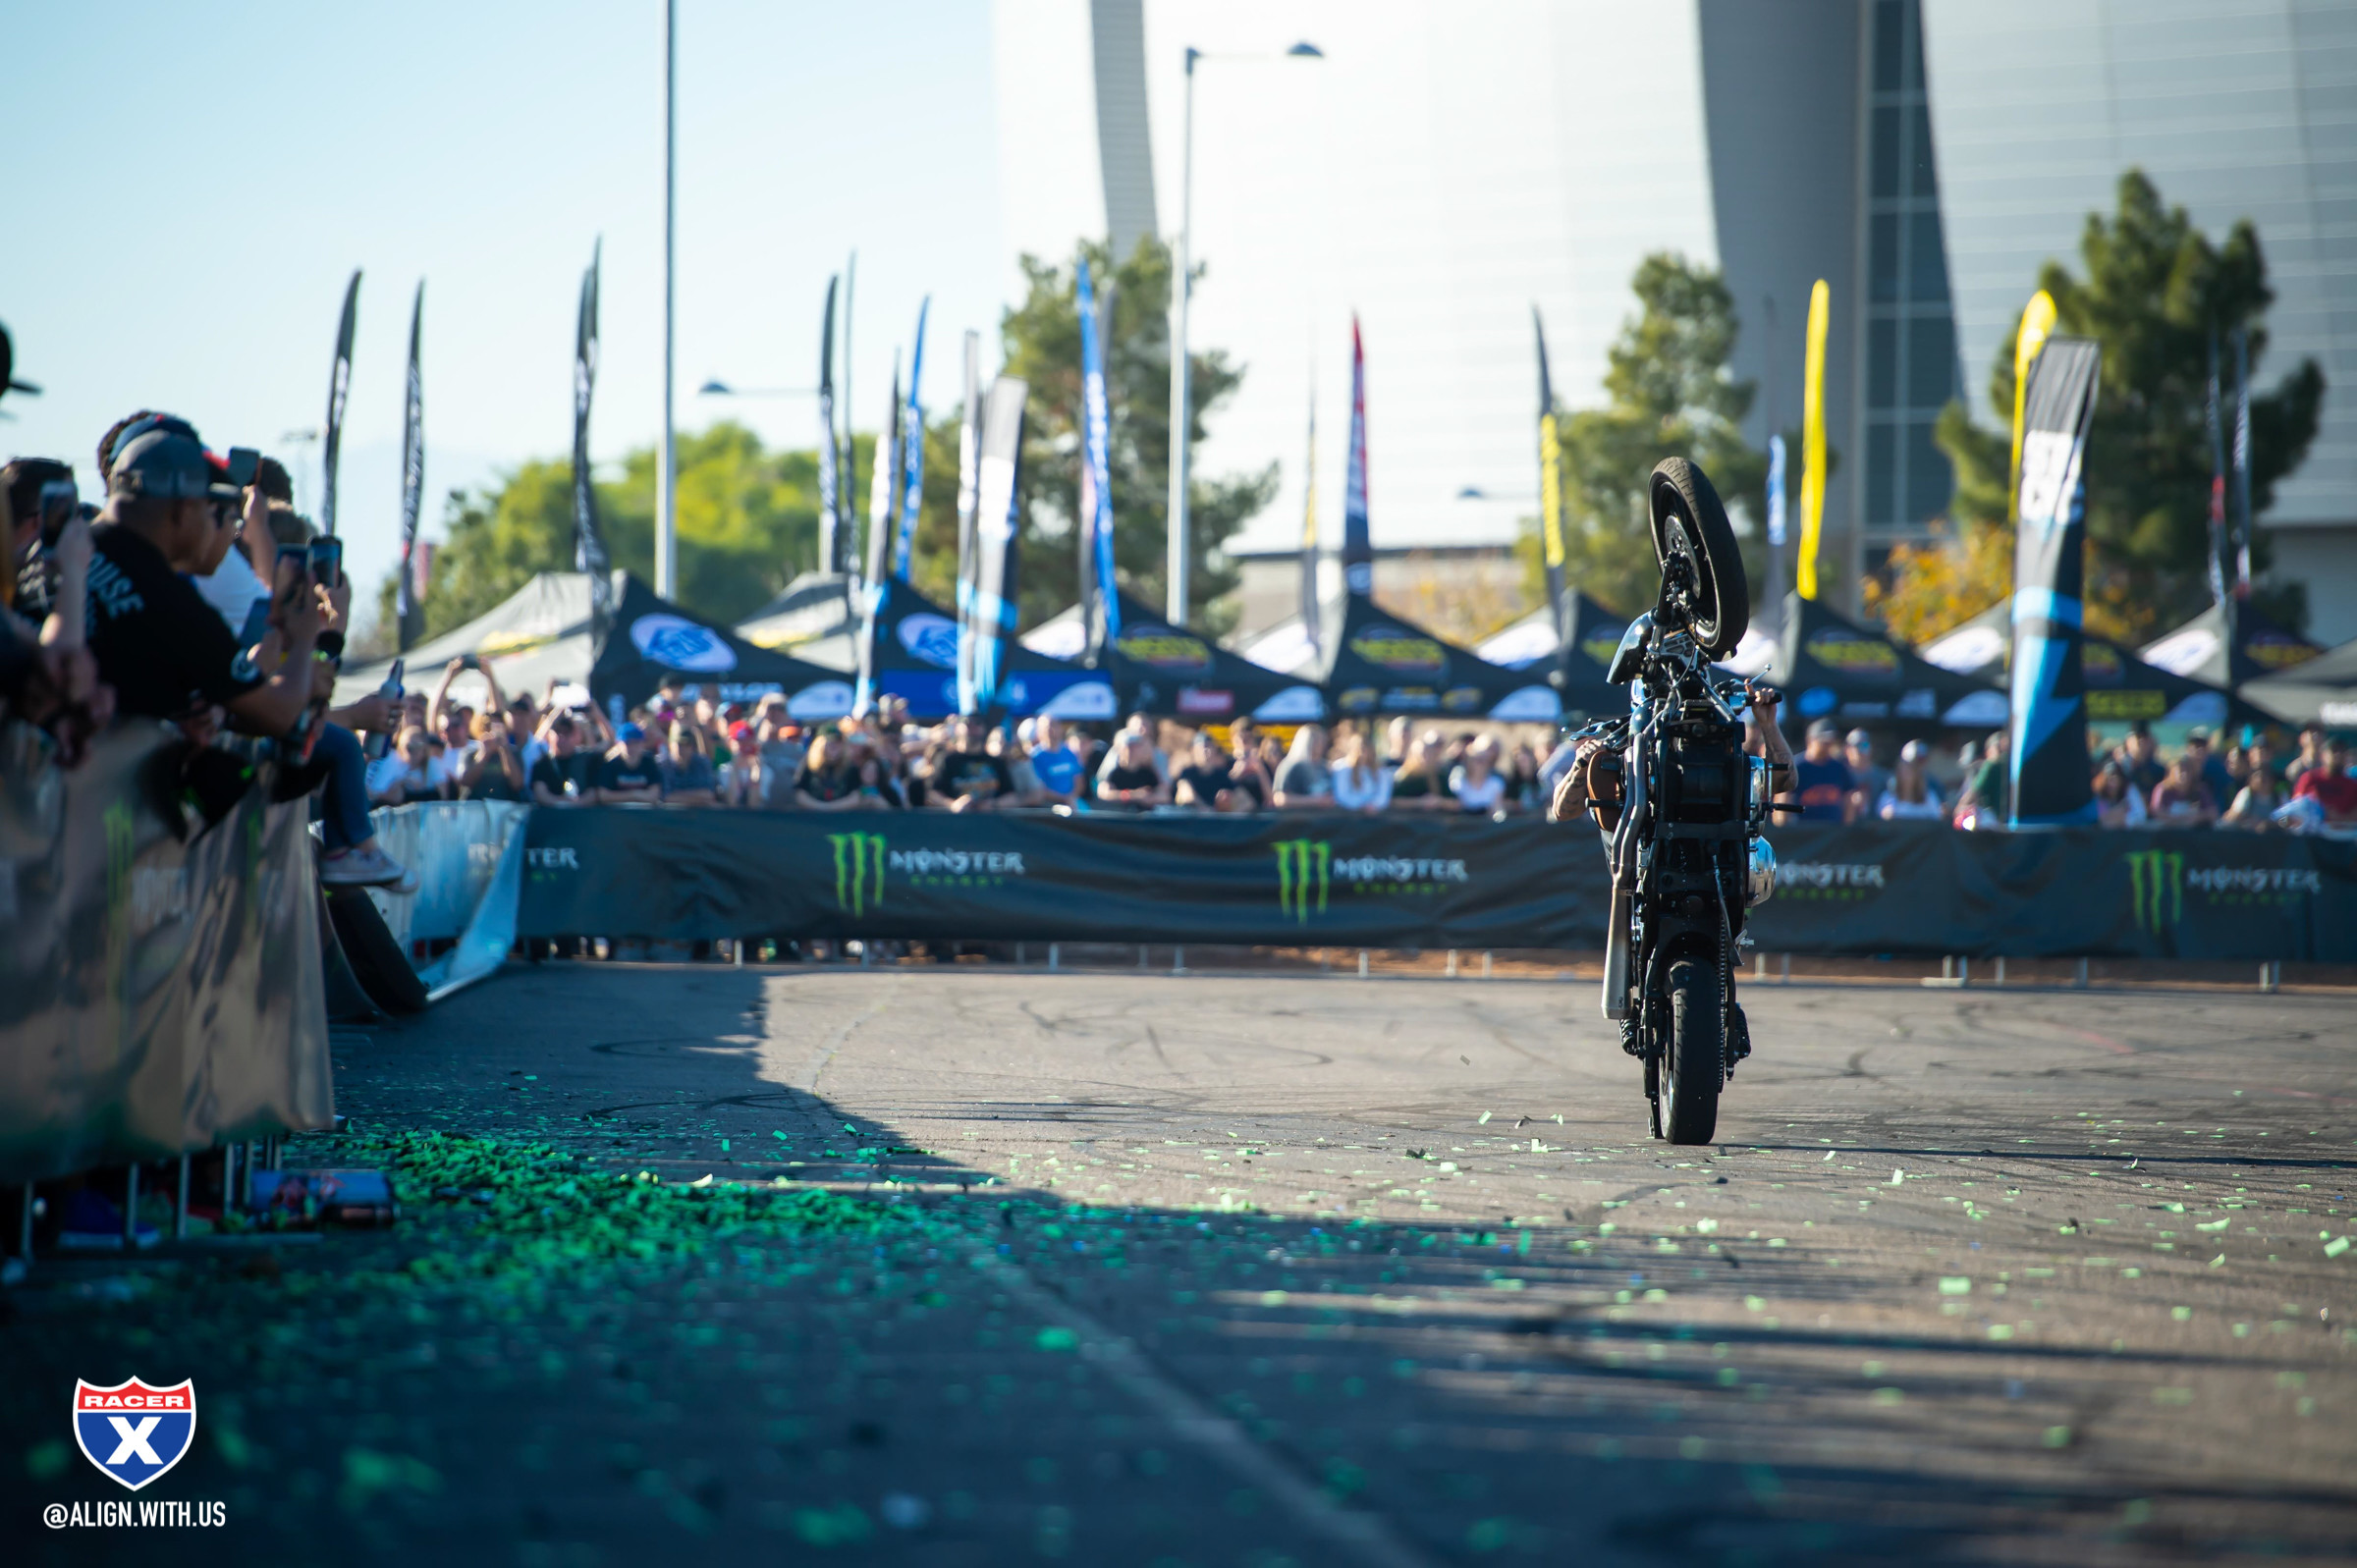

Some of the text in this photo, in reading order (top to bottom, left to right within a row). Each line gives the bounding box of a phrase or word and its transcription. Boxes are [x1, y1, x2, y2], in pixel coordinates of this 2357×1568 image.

[889, 847, 1025, 875] MONSTER
[1333, 854, 1468, 883] MONSTER
[1776, 859, 1885, 888] ONSTER
[2186, 865, 2322, 893] MONSTER
